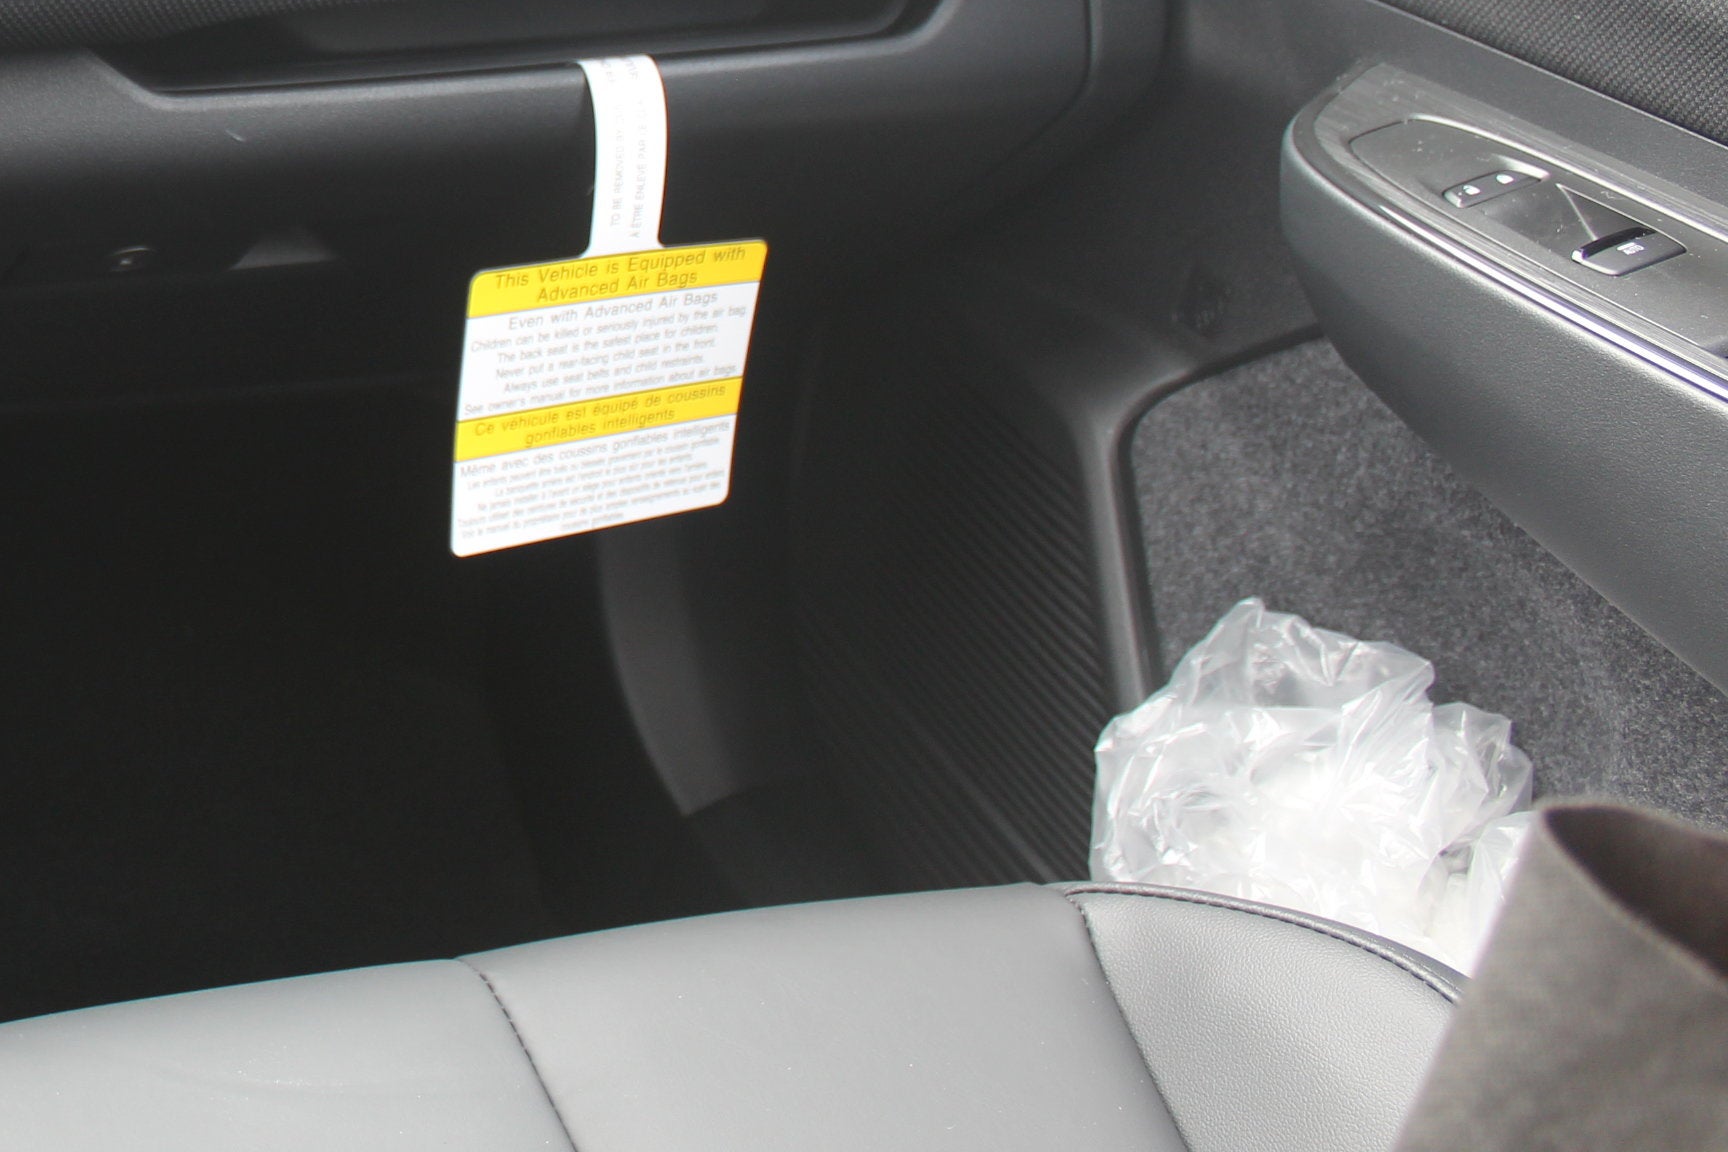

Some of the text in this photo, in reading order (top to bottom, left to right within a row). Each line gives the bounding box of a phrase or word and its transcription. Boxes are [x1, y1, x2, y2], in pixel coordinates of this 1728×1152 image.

[495, 246, 746, 289] This Vehicle is Equipped with
[536, 269, 698, 302] Advanced Air Bags
[508, 289, 719, 330] Even with Advanced Air Bags
[475, 420, 495, 436] Ce
[565, 407, 585, 420] est
[644, 393, 662, 407] de
[667, 383, 726, 403] coussins
[524, 407, 675, 449] gonflables intelligents
